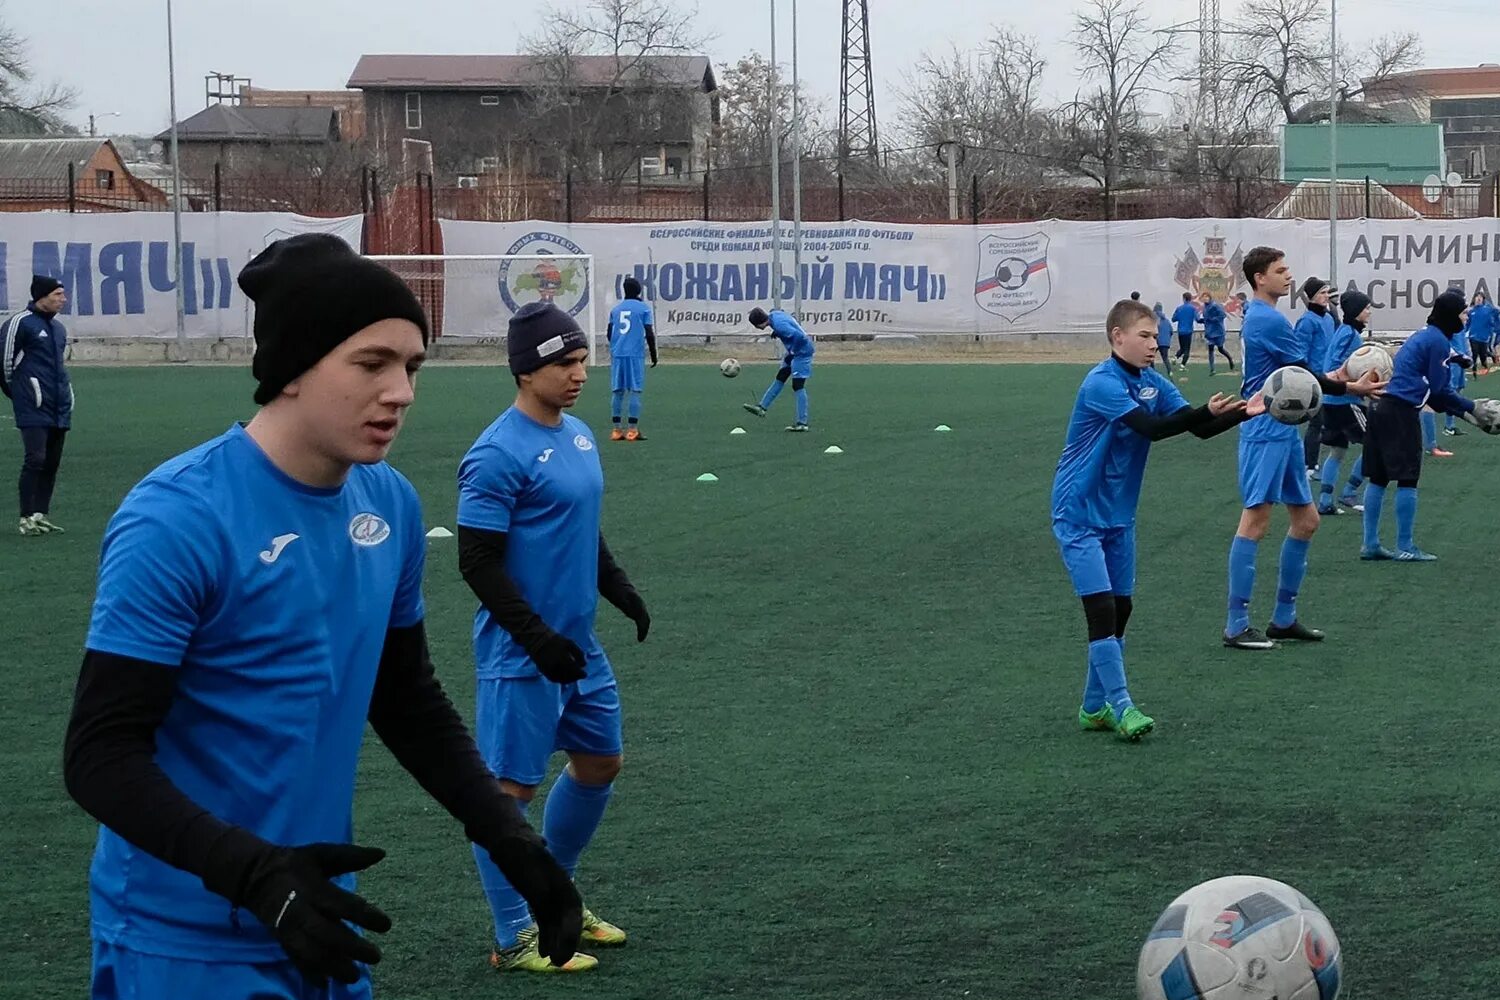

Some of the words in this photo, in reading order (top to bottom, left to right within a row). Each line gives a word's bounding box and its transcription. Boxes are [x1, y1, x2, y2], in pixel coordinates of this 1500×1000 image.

[788, 227, 857, 239] СРЕВНОВАНИЯ
[803, 240, 852, 252] 2004-2005
[32, 240, 233, 316] МЯЧ»
[844, 262, 946, 303] МЯЧ»
[619, 310, 631, 335] 5
[667, 309, 742, 325] Краснодар
[847, 308, 893, 324] 2017г.
